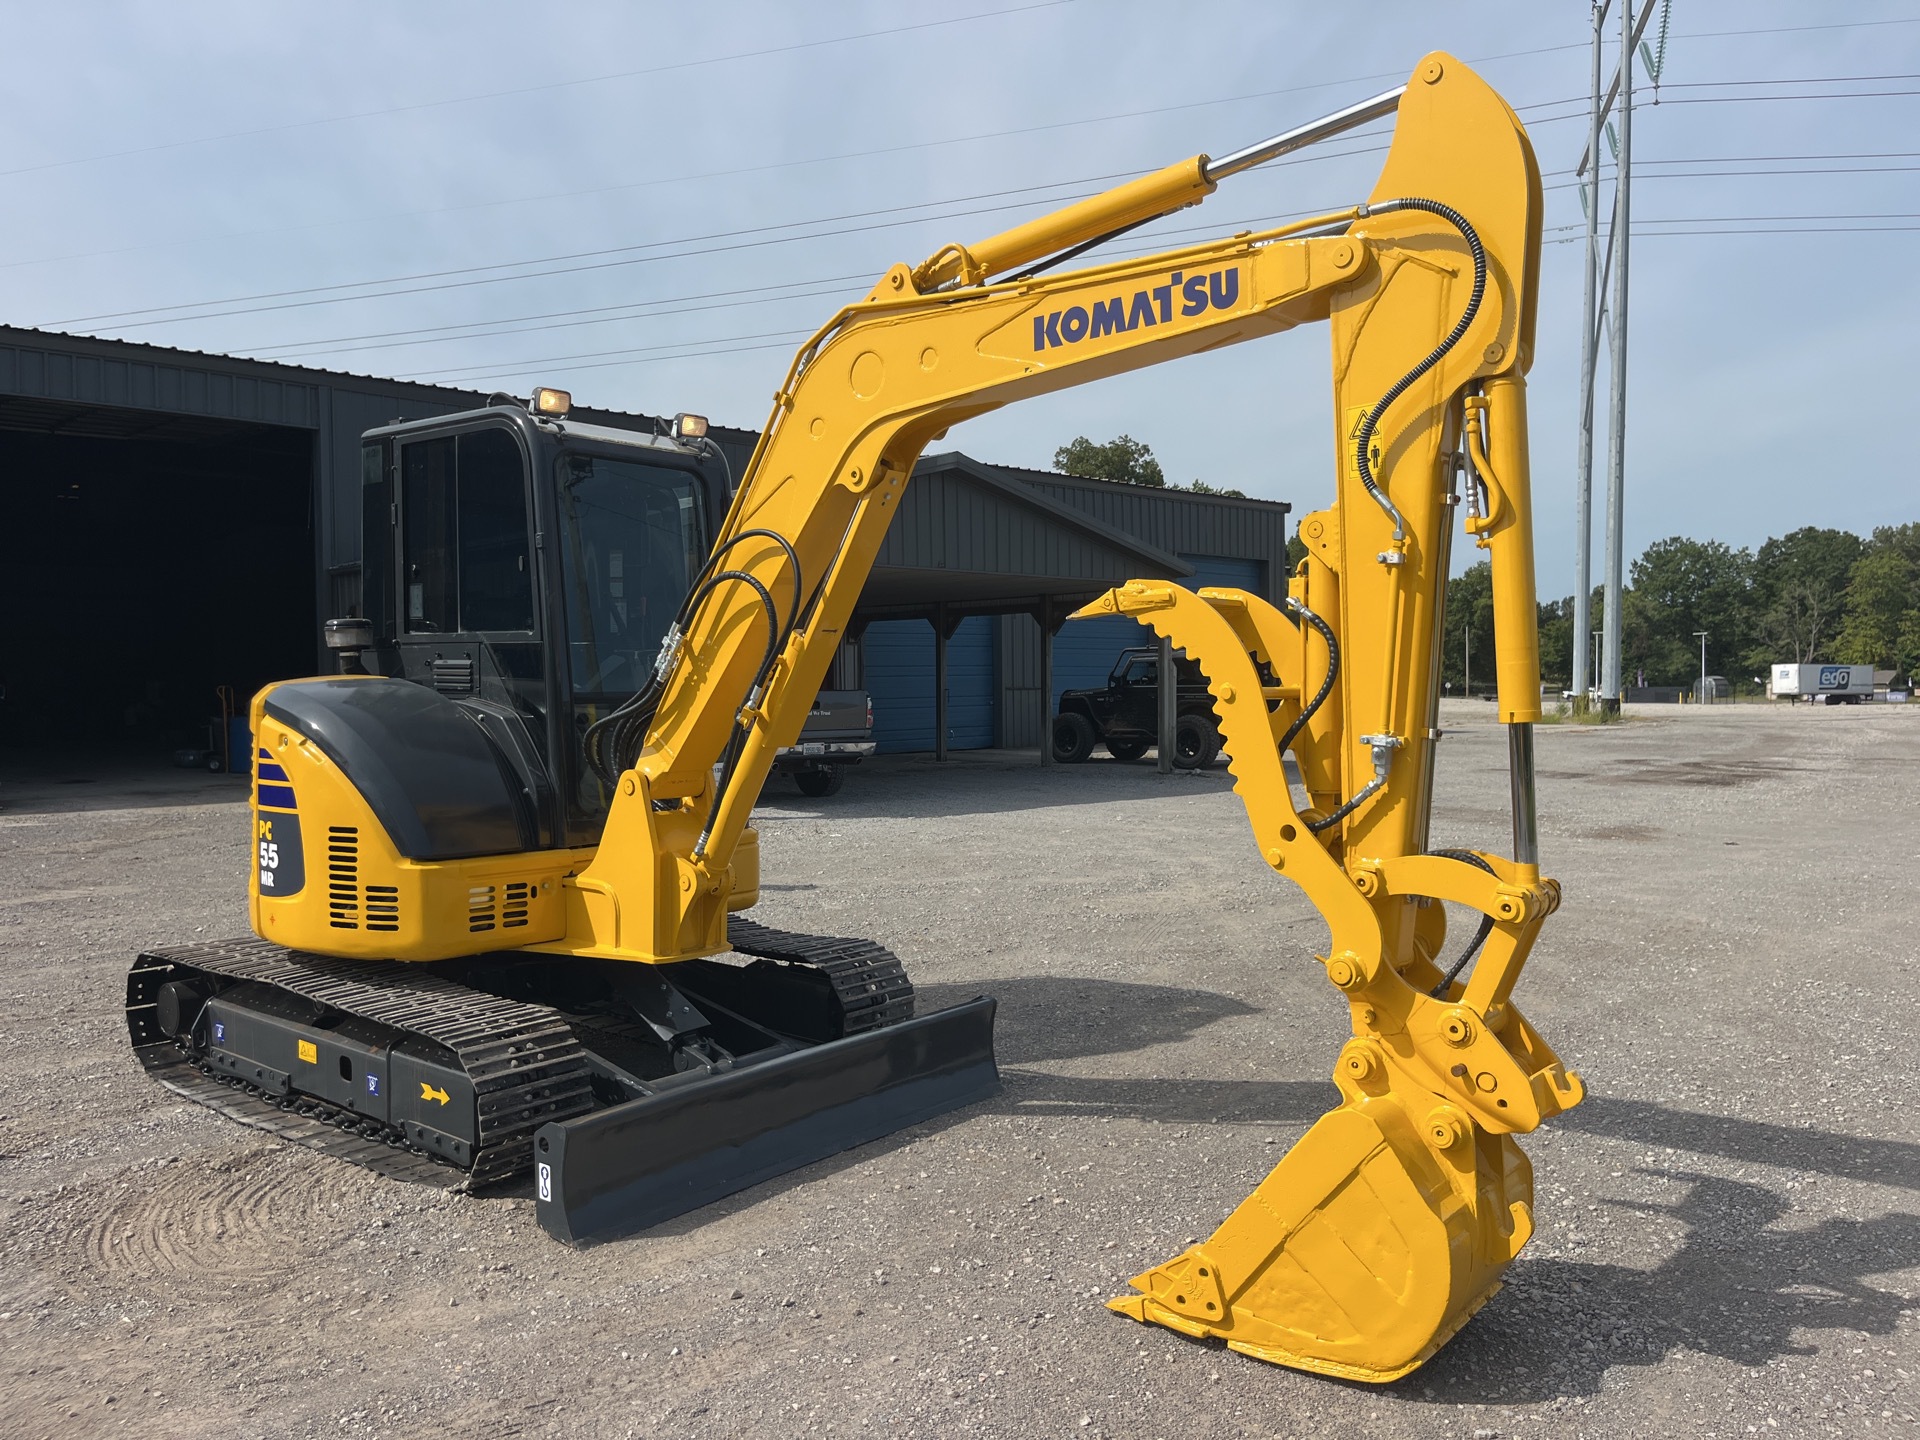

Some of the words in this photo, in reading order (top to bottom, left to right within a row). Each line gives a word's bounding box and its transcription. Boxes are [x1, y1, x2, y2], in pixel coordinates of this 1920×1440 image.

[1034, 267, 1239, 352] KOMATSU
[259, 820, 273, 841] PC
[260, 841, 279, 869] 55
[261, 869, 274, 887] MR
